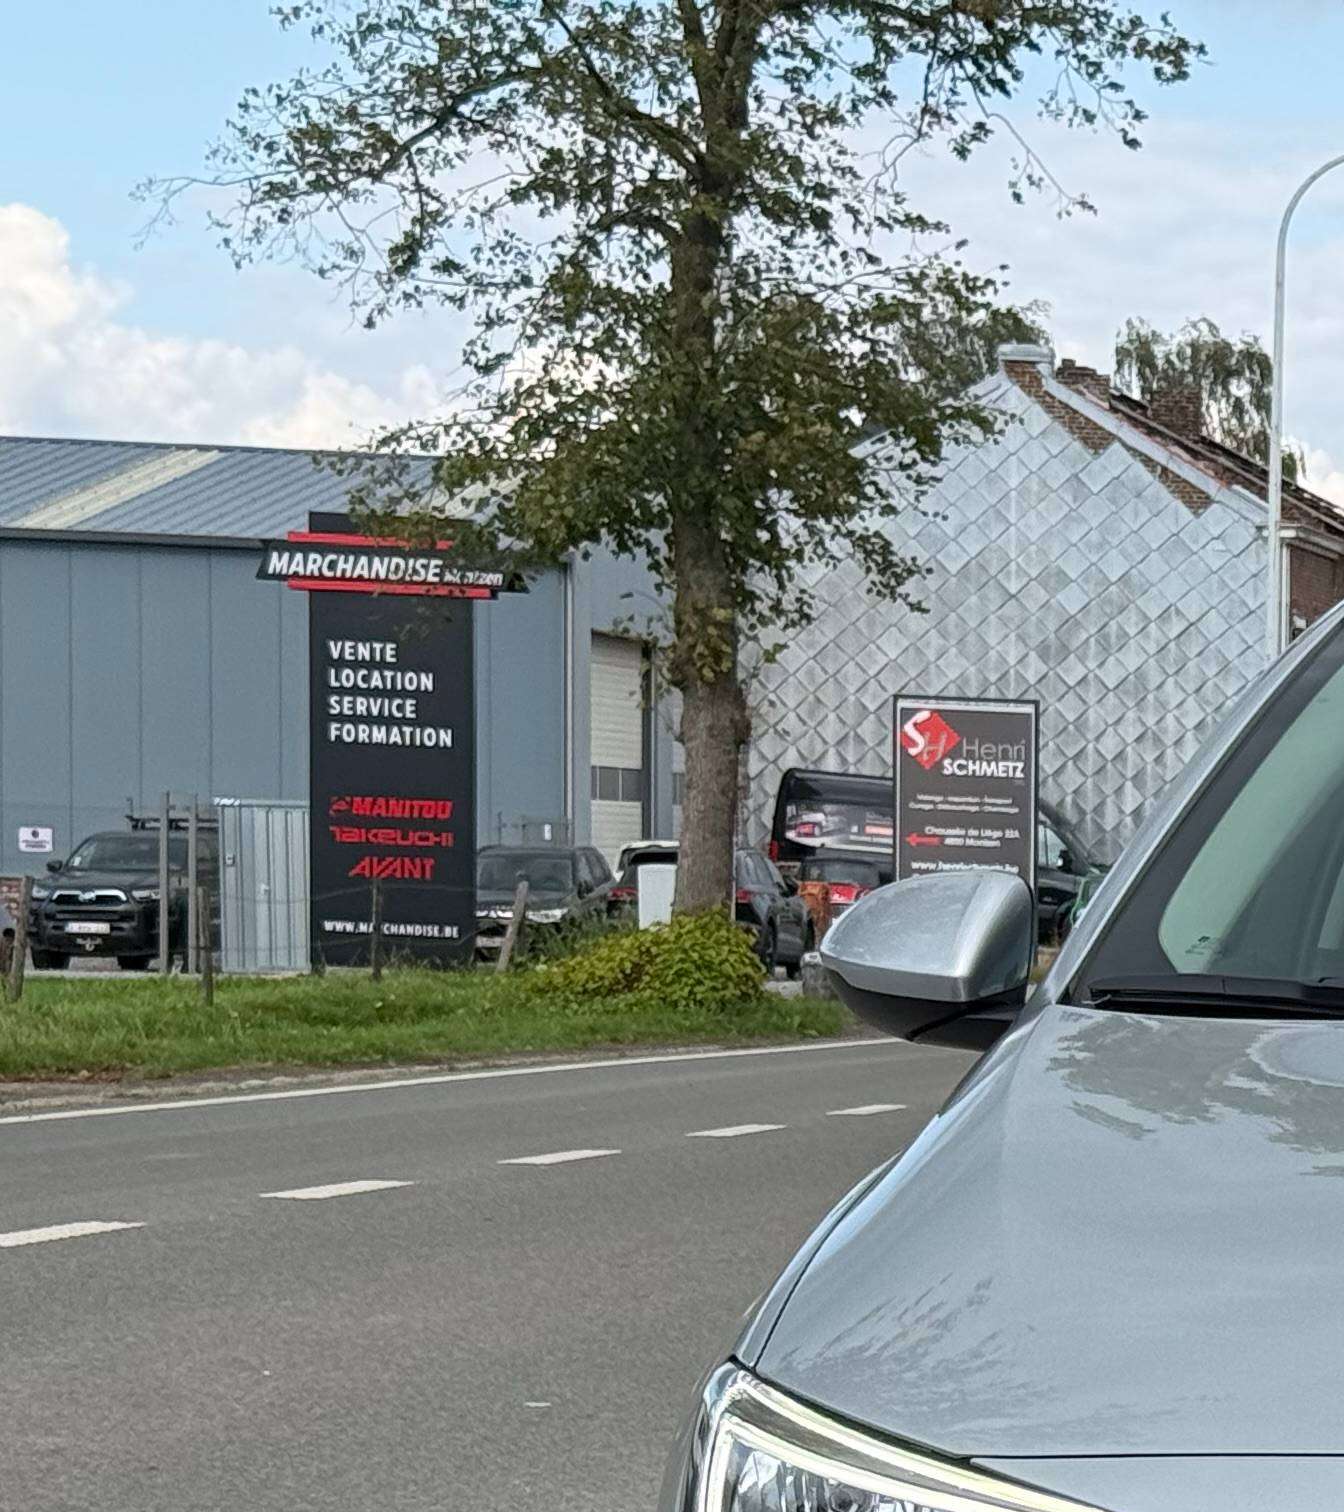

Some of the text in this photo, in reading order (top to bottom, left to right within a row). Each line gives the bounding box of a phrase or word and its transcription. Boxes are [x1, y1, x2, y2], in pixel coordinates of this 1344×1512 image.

[267, 551, 444, 583] MARCHANDISE
[328, 640, 398, 663] VENTE
[329, 667, 434, 692] LOCATION
[328, 695, 417, 719] SERVICE
[329, 722, 453, 748] FORMATION
[962, 736, 1026, 761] Henri
[941, 758, 1025, 779] SCHMETZ
[351, 796, 453, 819] MANITOU
[347, 856, 435, 879] AVANT
[323, 919, 460, 939] WWW.MACHANDISE.BE
